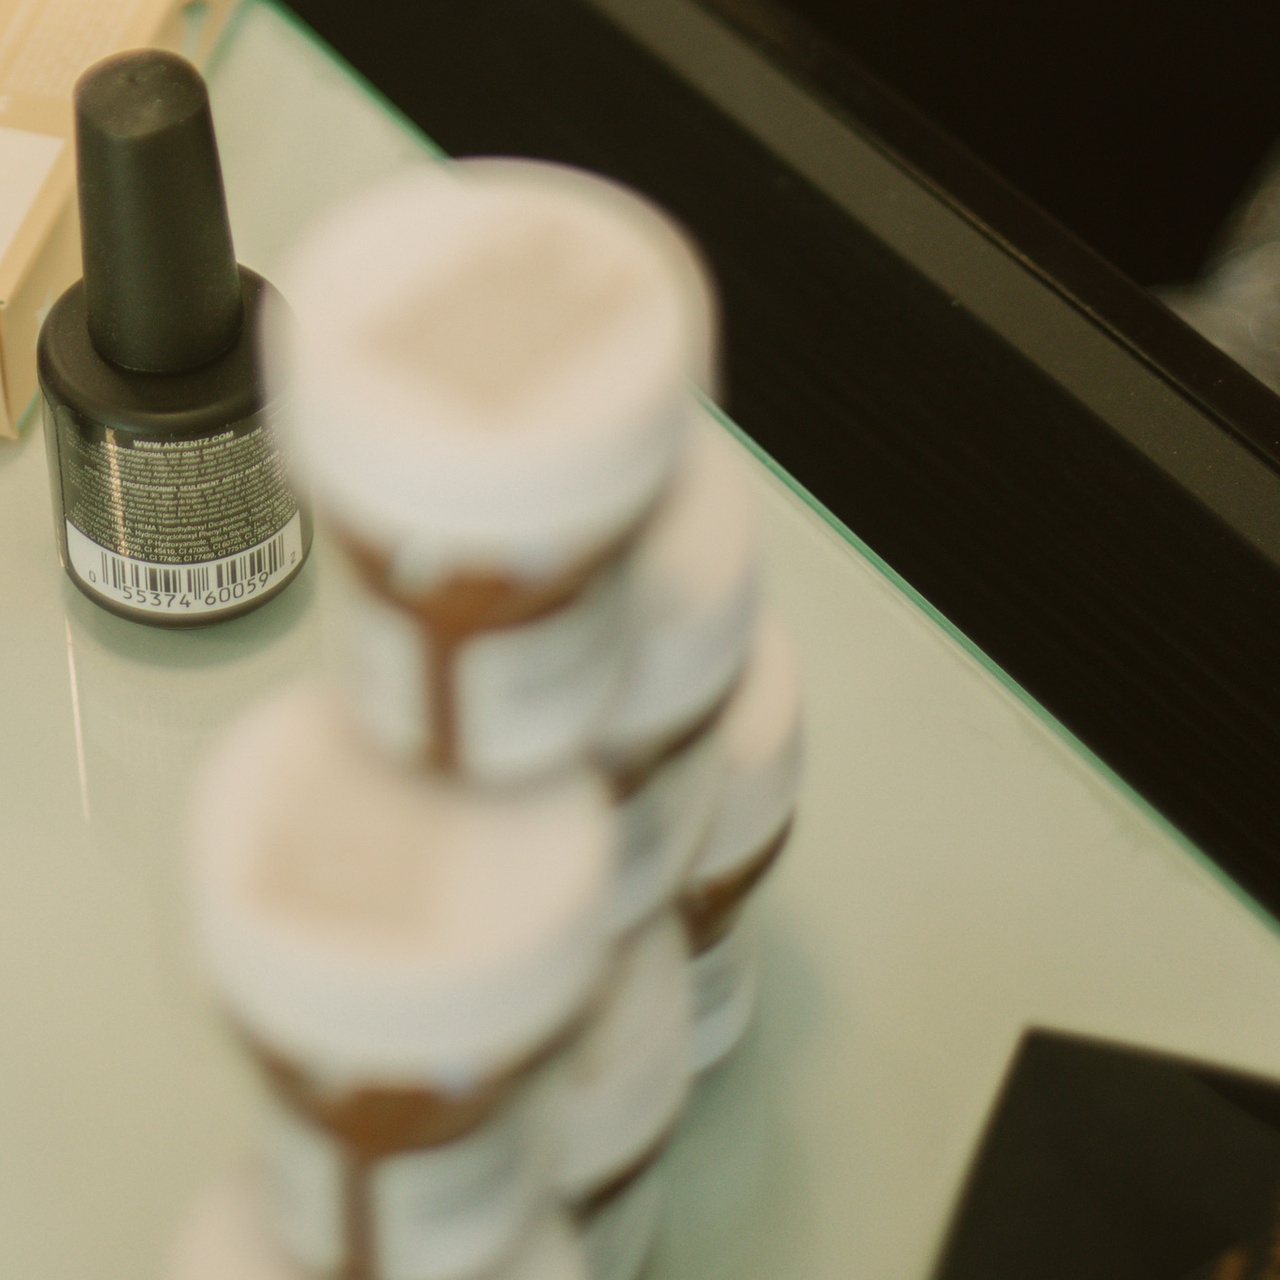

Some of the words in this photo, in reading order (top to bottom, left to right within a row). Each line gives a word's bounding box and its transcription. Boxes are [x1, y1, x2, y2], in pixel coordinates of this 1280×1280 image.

[133, 430, 233, 449] WWW.AKZENTZ.COM
[89, 570, 96, 583] 0
[122, 586, 191, 609] 55374
[205, 571, 270, 606] 60059
[289, 551, 297, 565] 2
